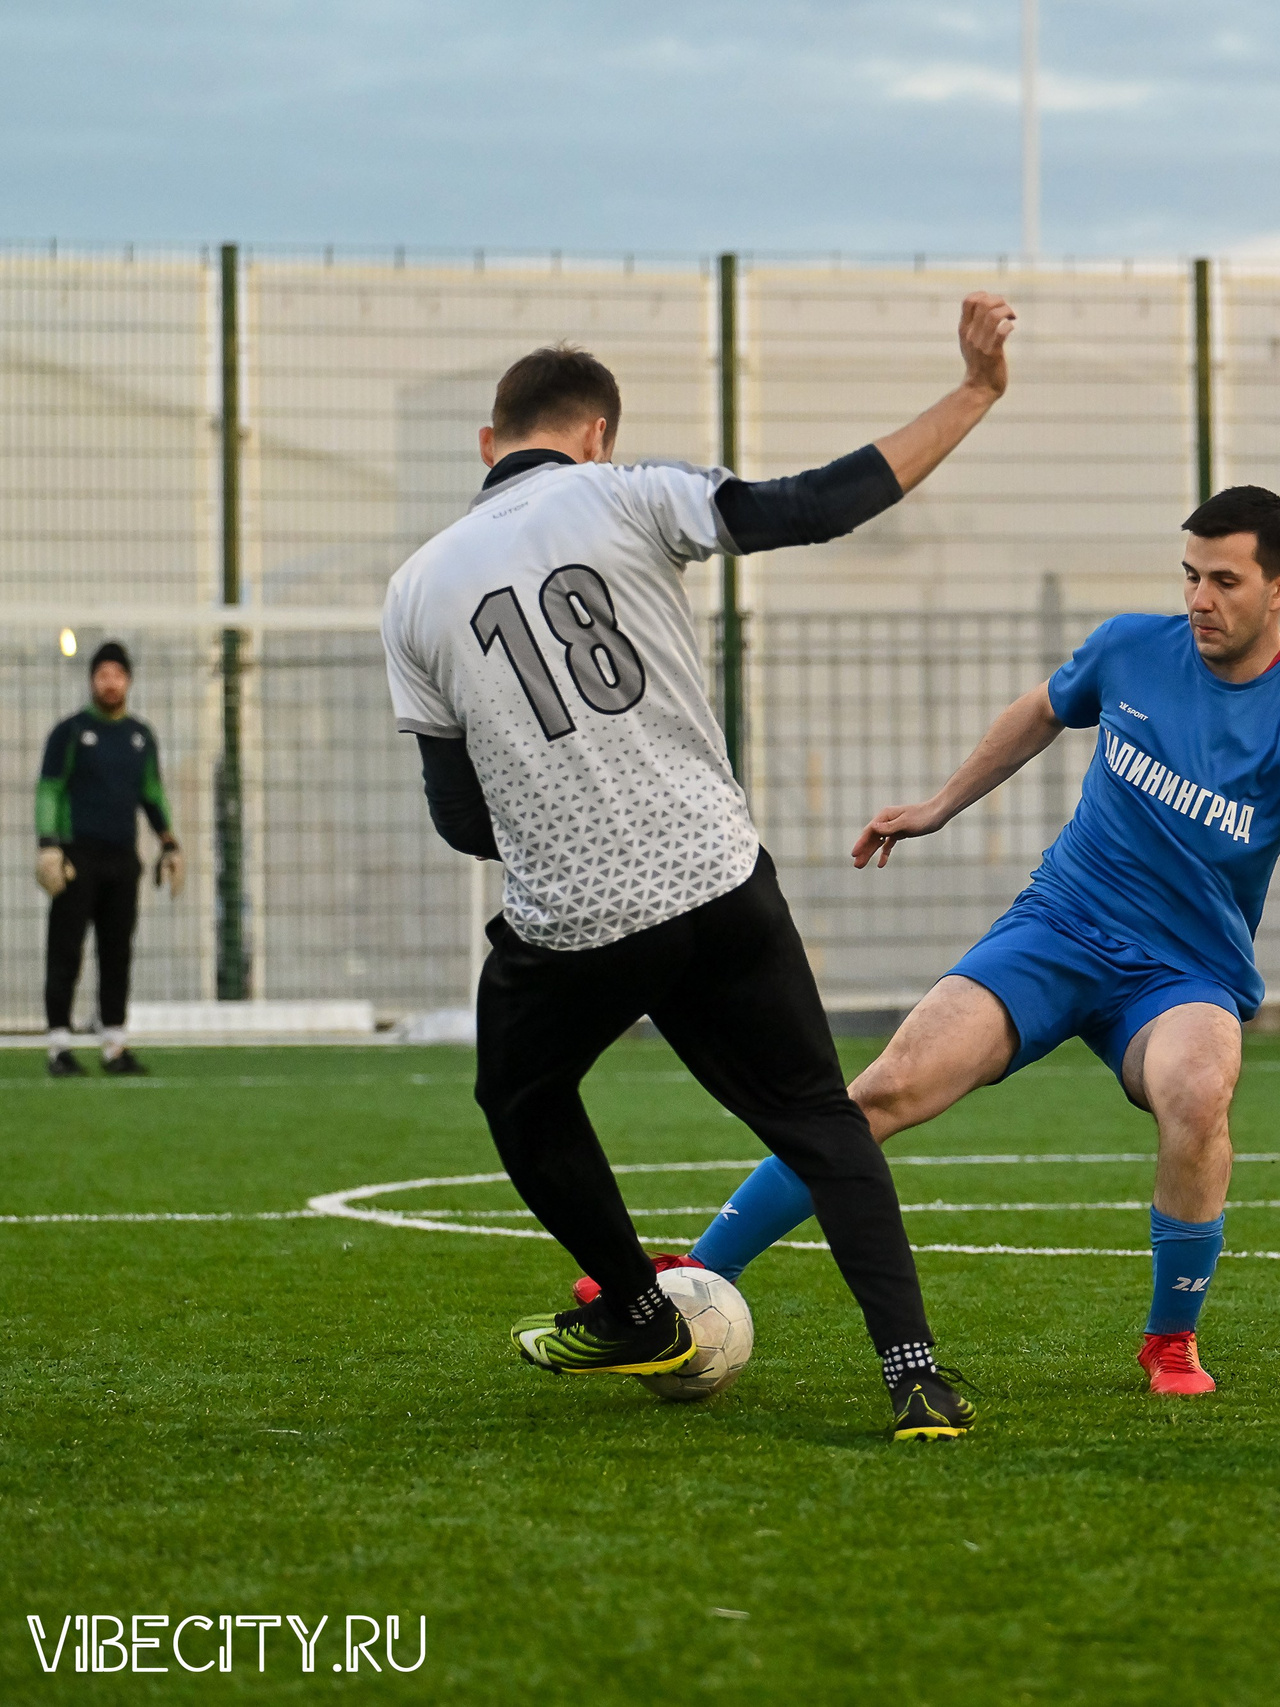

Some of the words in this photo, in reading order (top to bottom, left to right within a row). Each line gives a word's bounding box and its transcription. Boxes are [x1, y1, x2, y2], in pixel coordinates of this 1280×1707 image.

[469, 563, 646, 742] 18
[1126, 707, 1149, 721] SPORT
[1172, 1276, 1210, 1292] 2K
